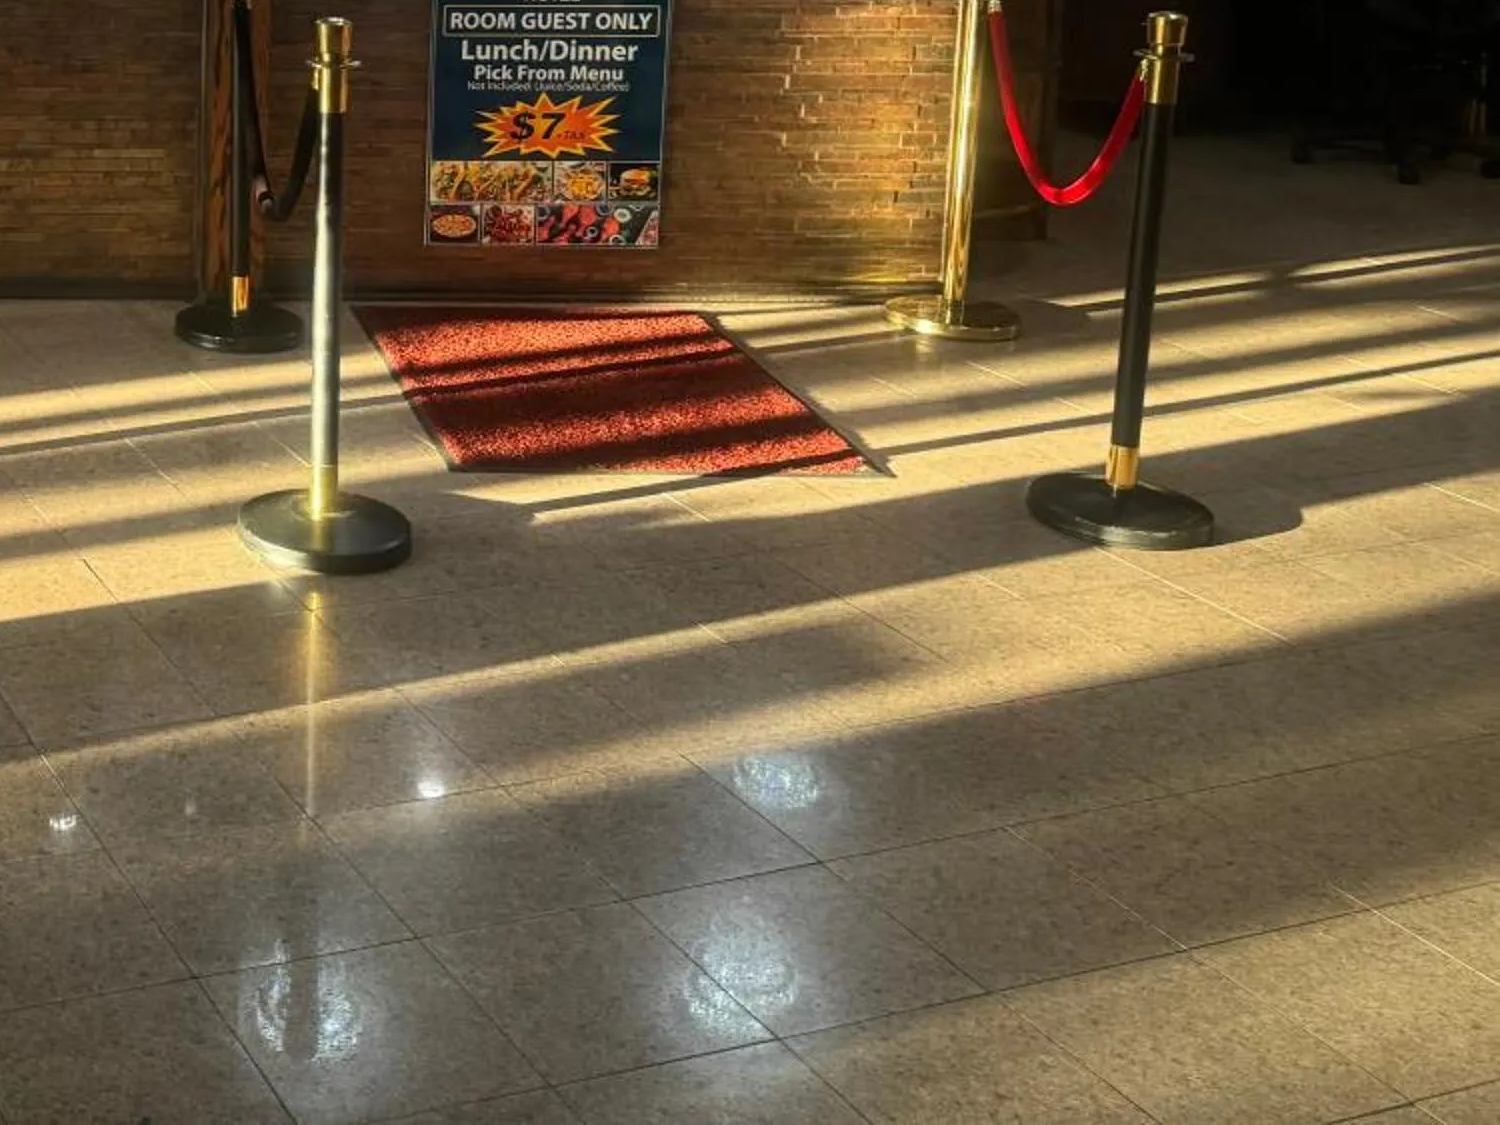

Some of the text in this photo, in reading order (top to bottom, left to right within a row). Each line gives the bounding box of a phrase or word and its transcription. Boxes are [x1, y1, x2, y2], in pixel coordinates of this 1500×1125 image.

[450, 12, 653, 30] ROOM GUEST ONLY
[461, 38, 639, 61] Lunch/Dinner
[474, 64, 624, 81] Pick From Menu
[509, 111, 566, 141] $7
